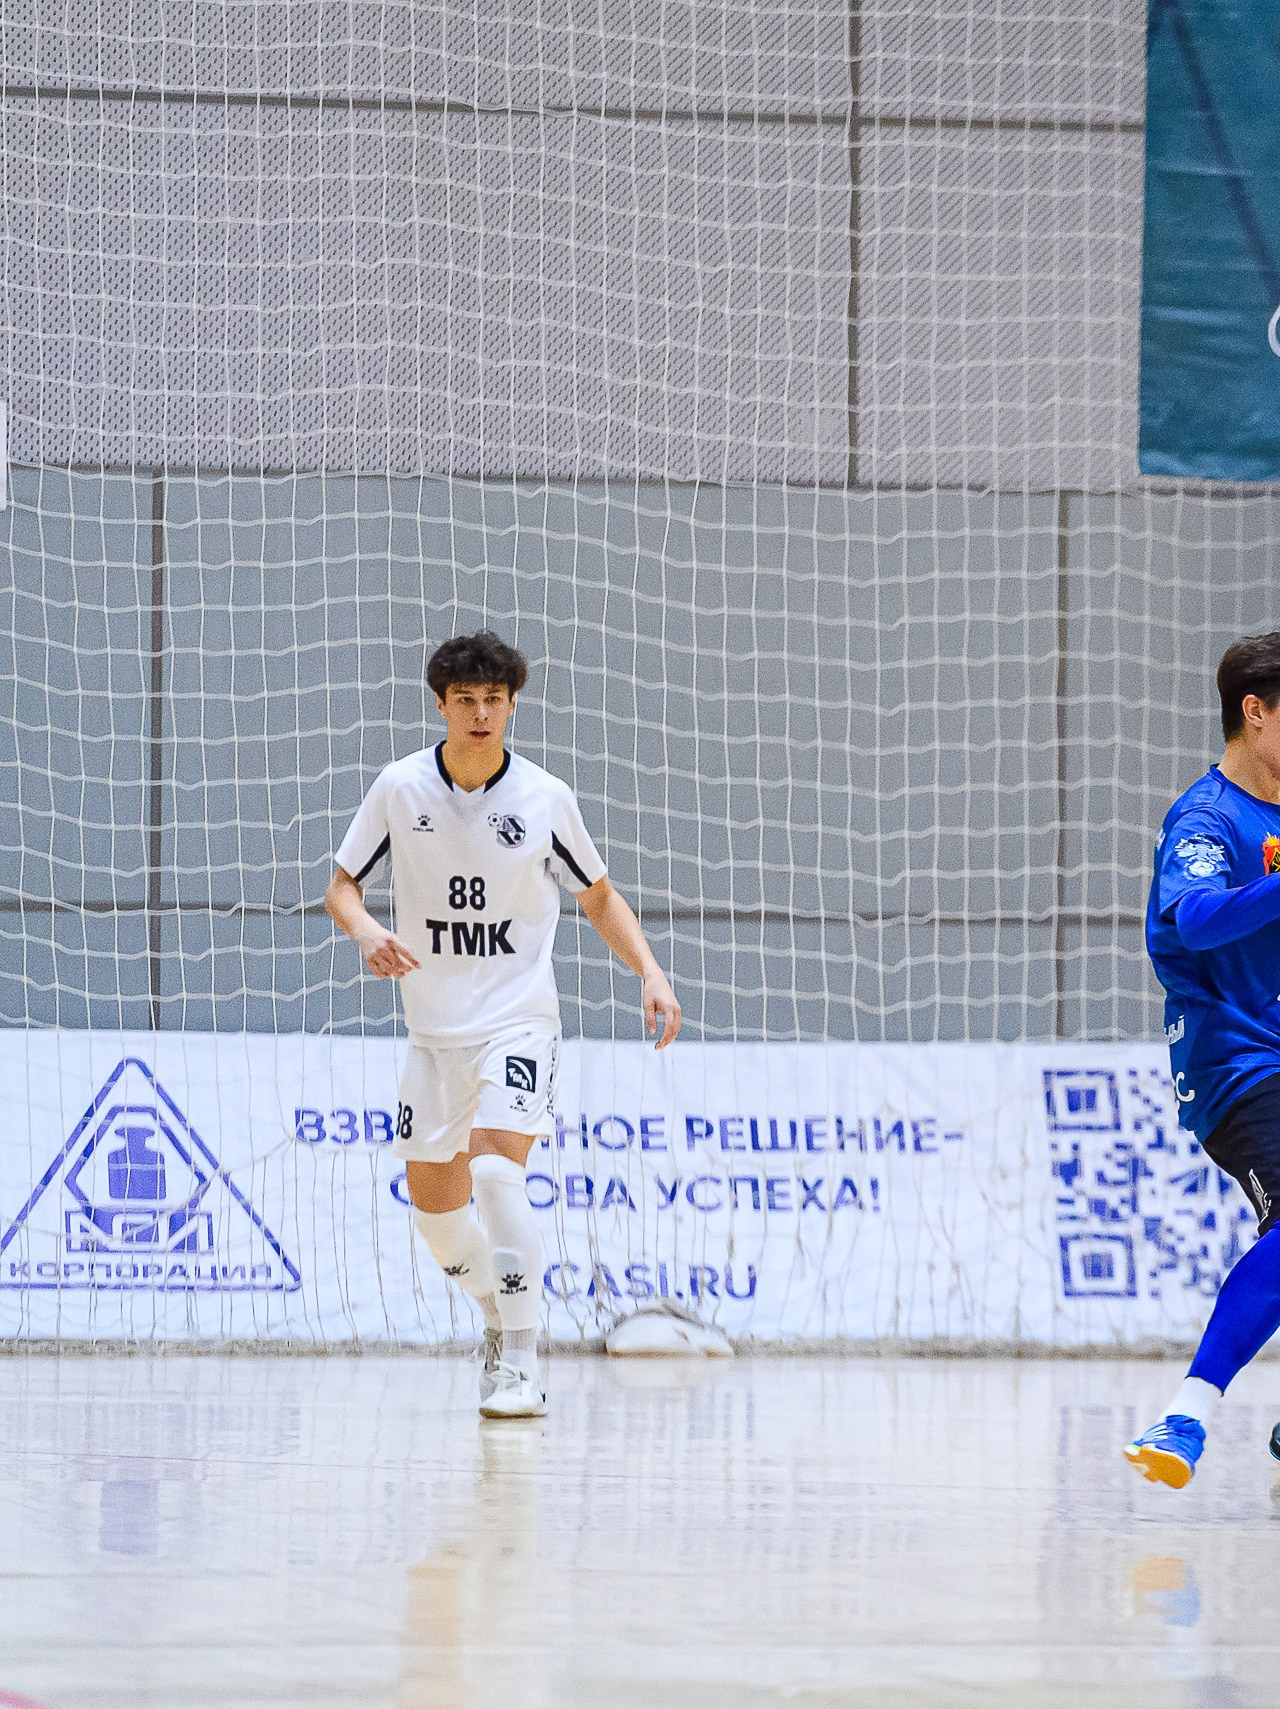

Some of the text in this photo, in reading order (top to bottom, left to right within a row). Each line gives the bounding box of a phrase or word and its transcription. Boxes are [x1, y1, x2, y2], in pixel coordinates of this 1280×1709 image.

[448, 875, 487, 911] 88
[295, 1107, 965, 1153] ВЗВНОЕ РЕШЕНИЕ-
[656, 1175, 881, 1213] УСПЕХА!
[9, 1261, 272, 1281] КОРПОРАЦИЯ
[543, 1262, 757, 1300] CASI.RU
